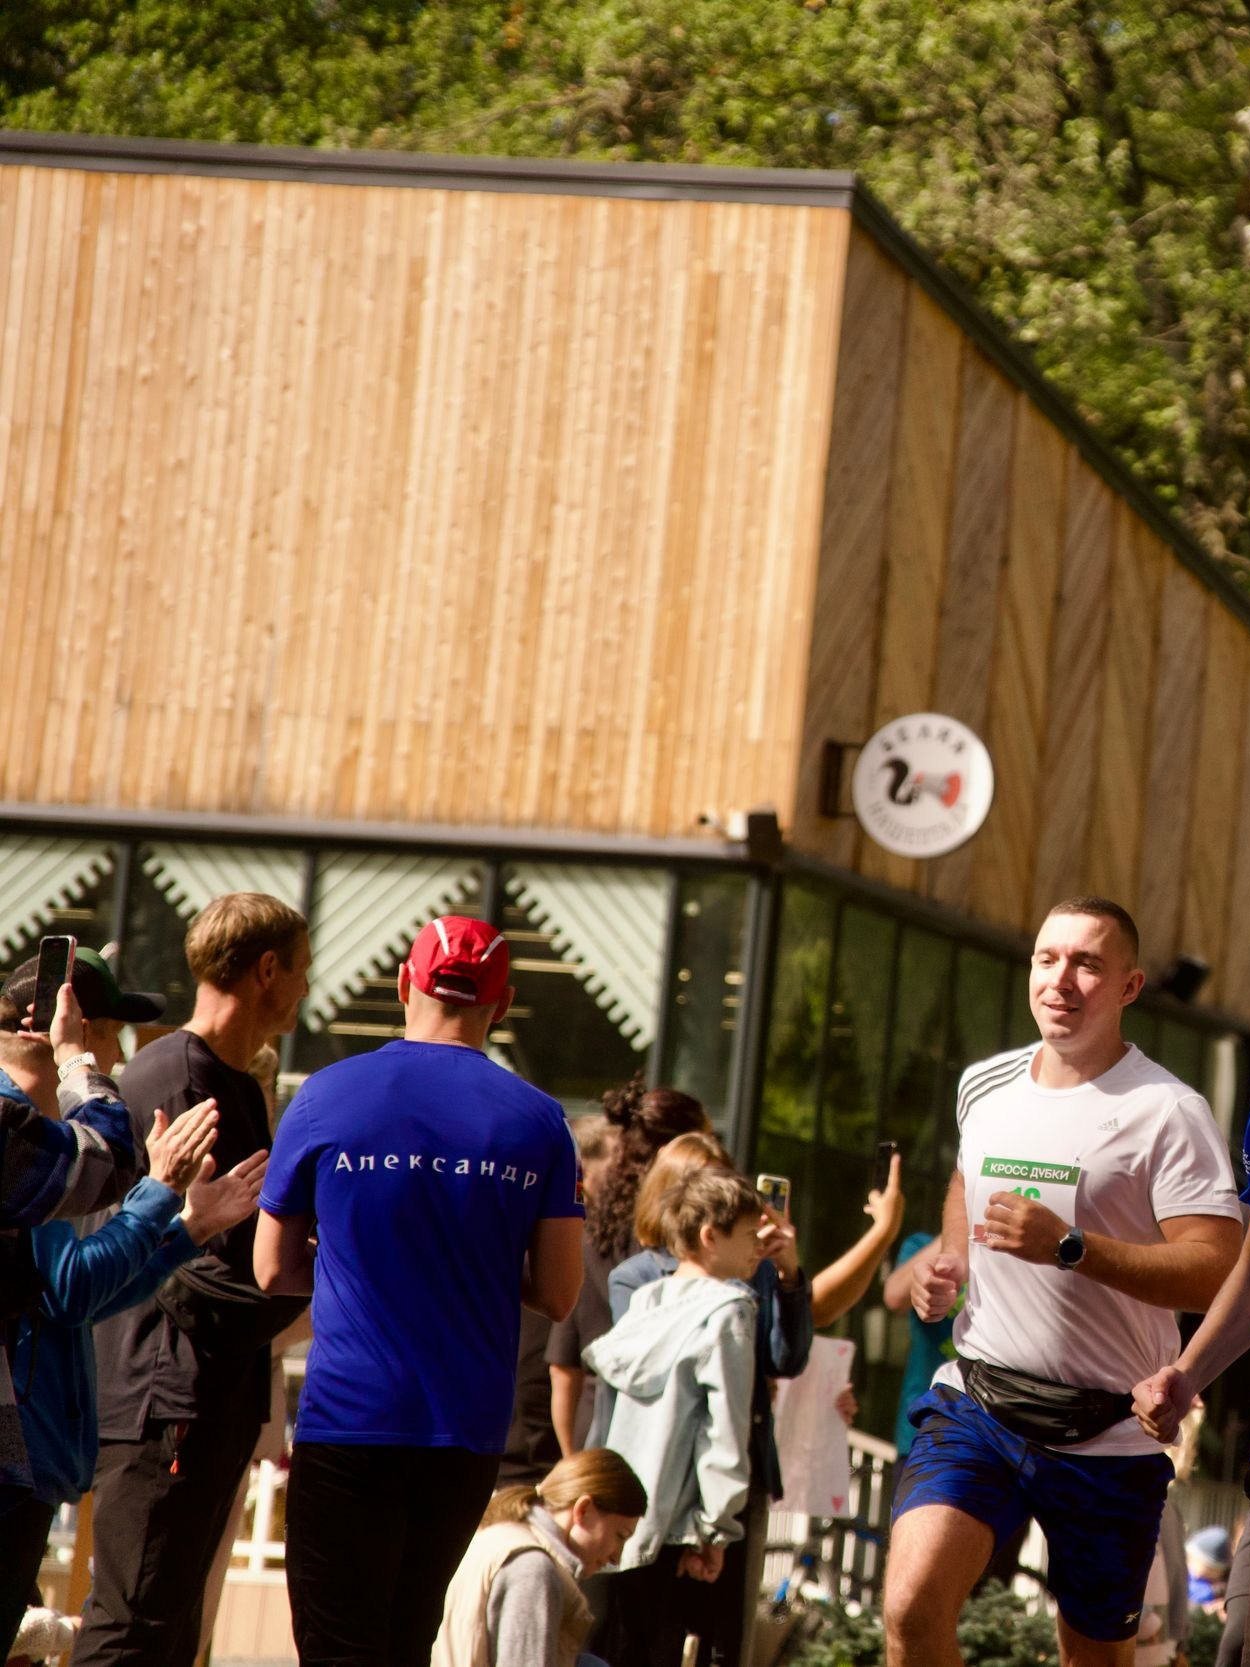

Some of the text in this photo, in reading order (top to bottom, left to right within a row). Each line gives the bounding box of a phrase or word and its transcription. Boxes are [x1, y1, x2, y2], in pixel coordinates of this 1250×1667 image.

[335, 1151, 538, 1190] Александр
[990, 1163, 1070, 1181] КРОСС ДУБКИ
